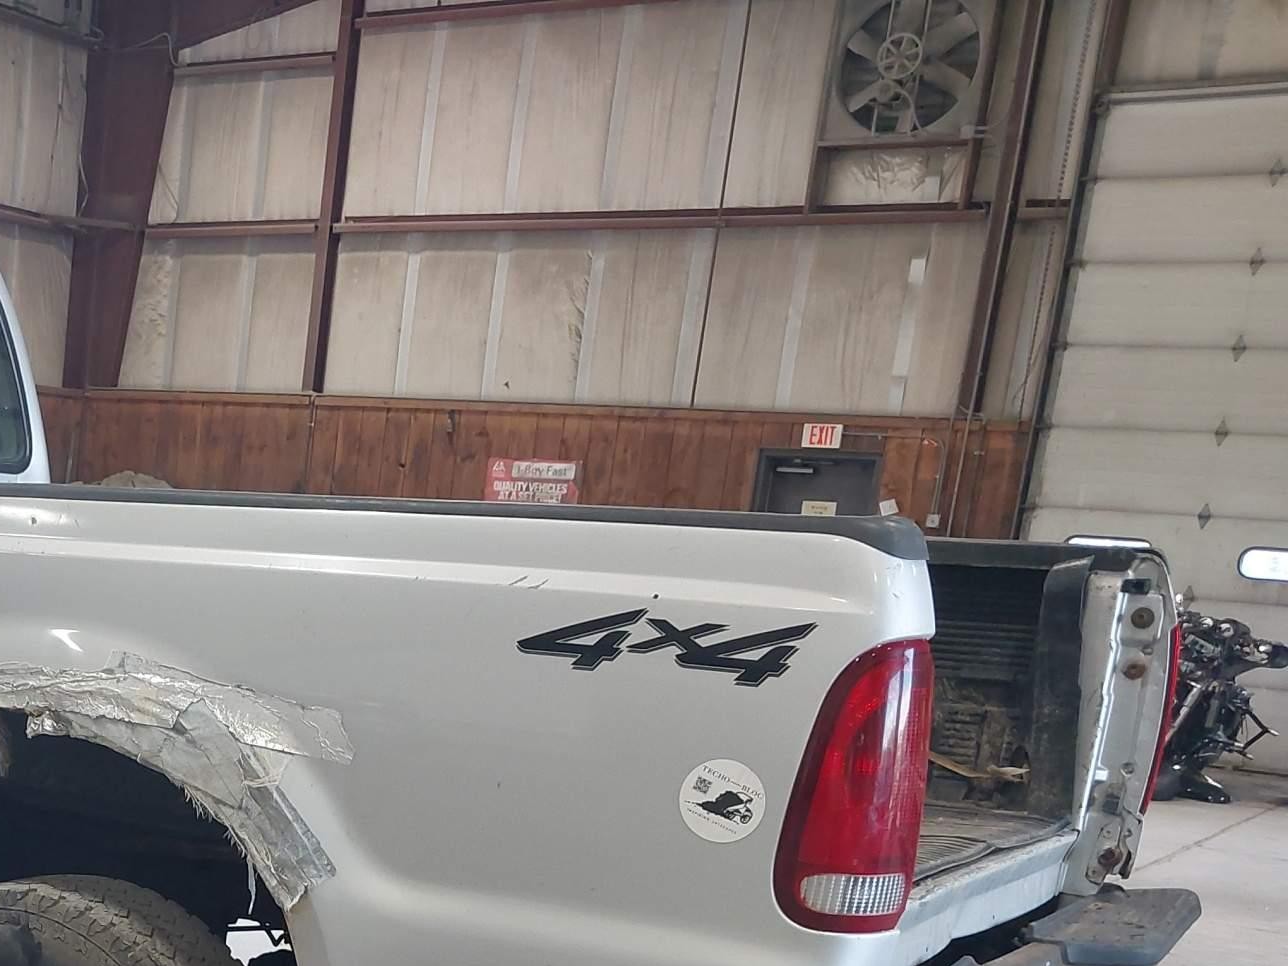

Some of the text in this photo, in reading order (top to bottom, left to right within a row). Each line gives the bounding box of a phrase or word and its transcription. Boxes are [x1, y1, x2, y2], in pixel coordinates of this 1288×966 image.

[809, 425, 838, 446] EXIT
[546, 466, 568, 477] Fast
[494, 480, 568, 495] QUALITY VEHICLES
